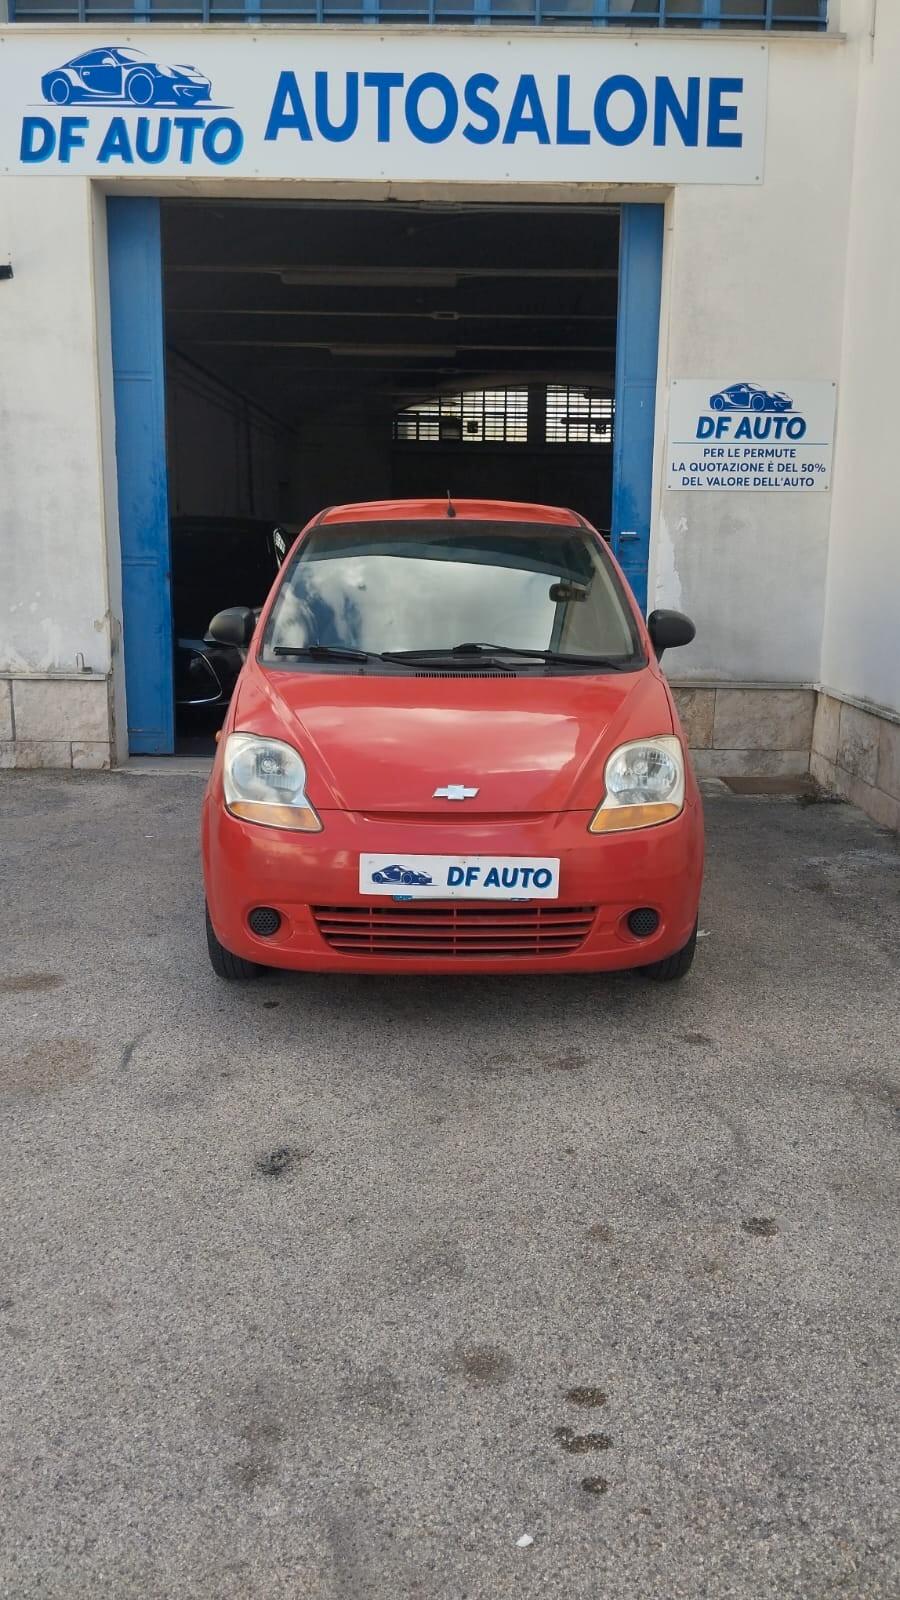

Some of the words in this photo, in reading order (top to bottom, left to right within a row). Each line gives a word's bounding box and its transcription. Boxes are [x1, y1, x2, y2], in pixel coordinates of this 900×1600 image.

[264, 71, 743, 148] AUTOSALONE
[19, 116, 90, 165] DF
[96, 116, 244, 166] AUTO
[696, 416, 732, 439] DF
[734, 416, 807, 440] AUTO
[703, 448, 724, 457] PER
[728, 449, 740, 458] LE
[744, 449, 796, 458] PERMUTE
[672, 462, 685, 471] LA
[689, 462, 764, 472] QUOTAZIONE
[768, 461, 774, 472] È
[777, 463, 798, 472] DEL
[801, 464, 826, 472] 50%
[682, 477, 702, 486] DEL
[707, 477, 750, 486] VALORE
[753, 478, 814, 487] DELL'AUTO
[447, 866, 481, 886] DF
[483, 868, 552, 888] AUTO
